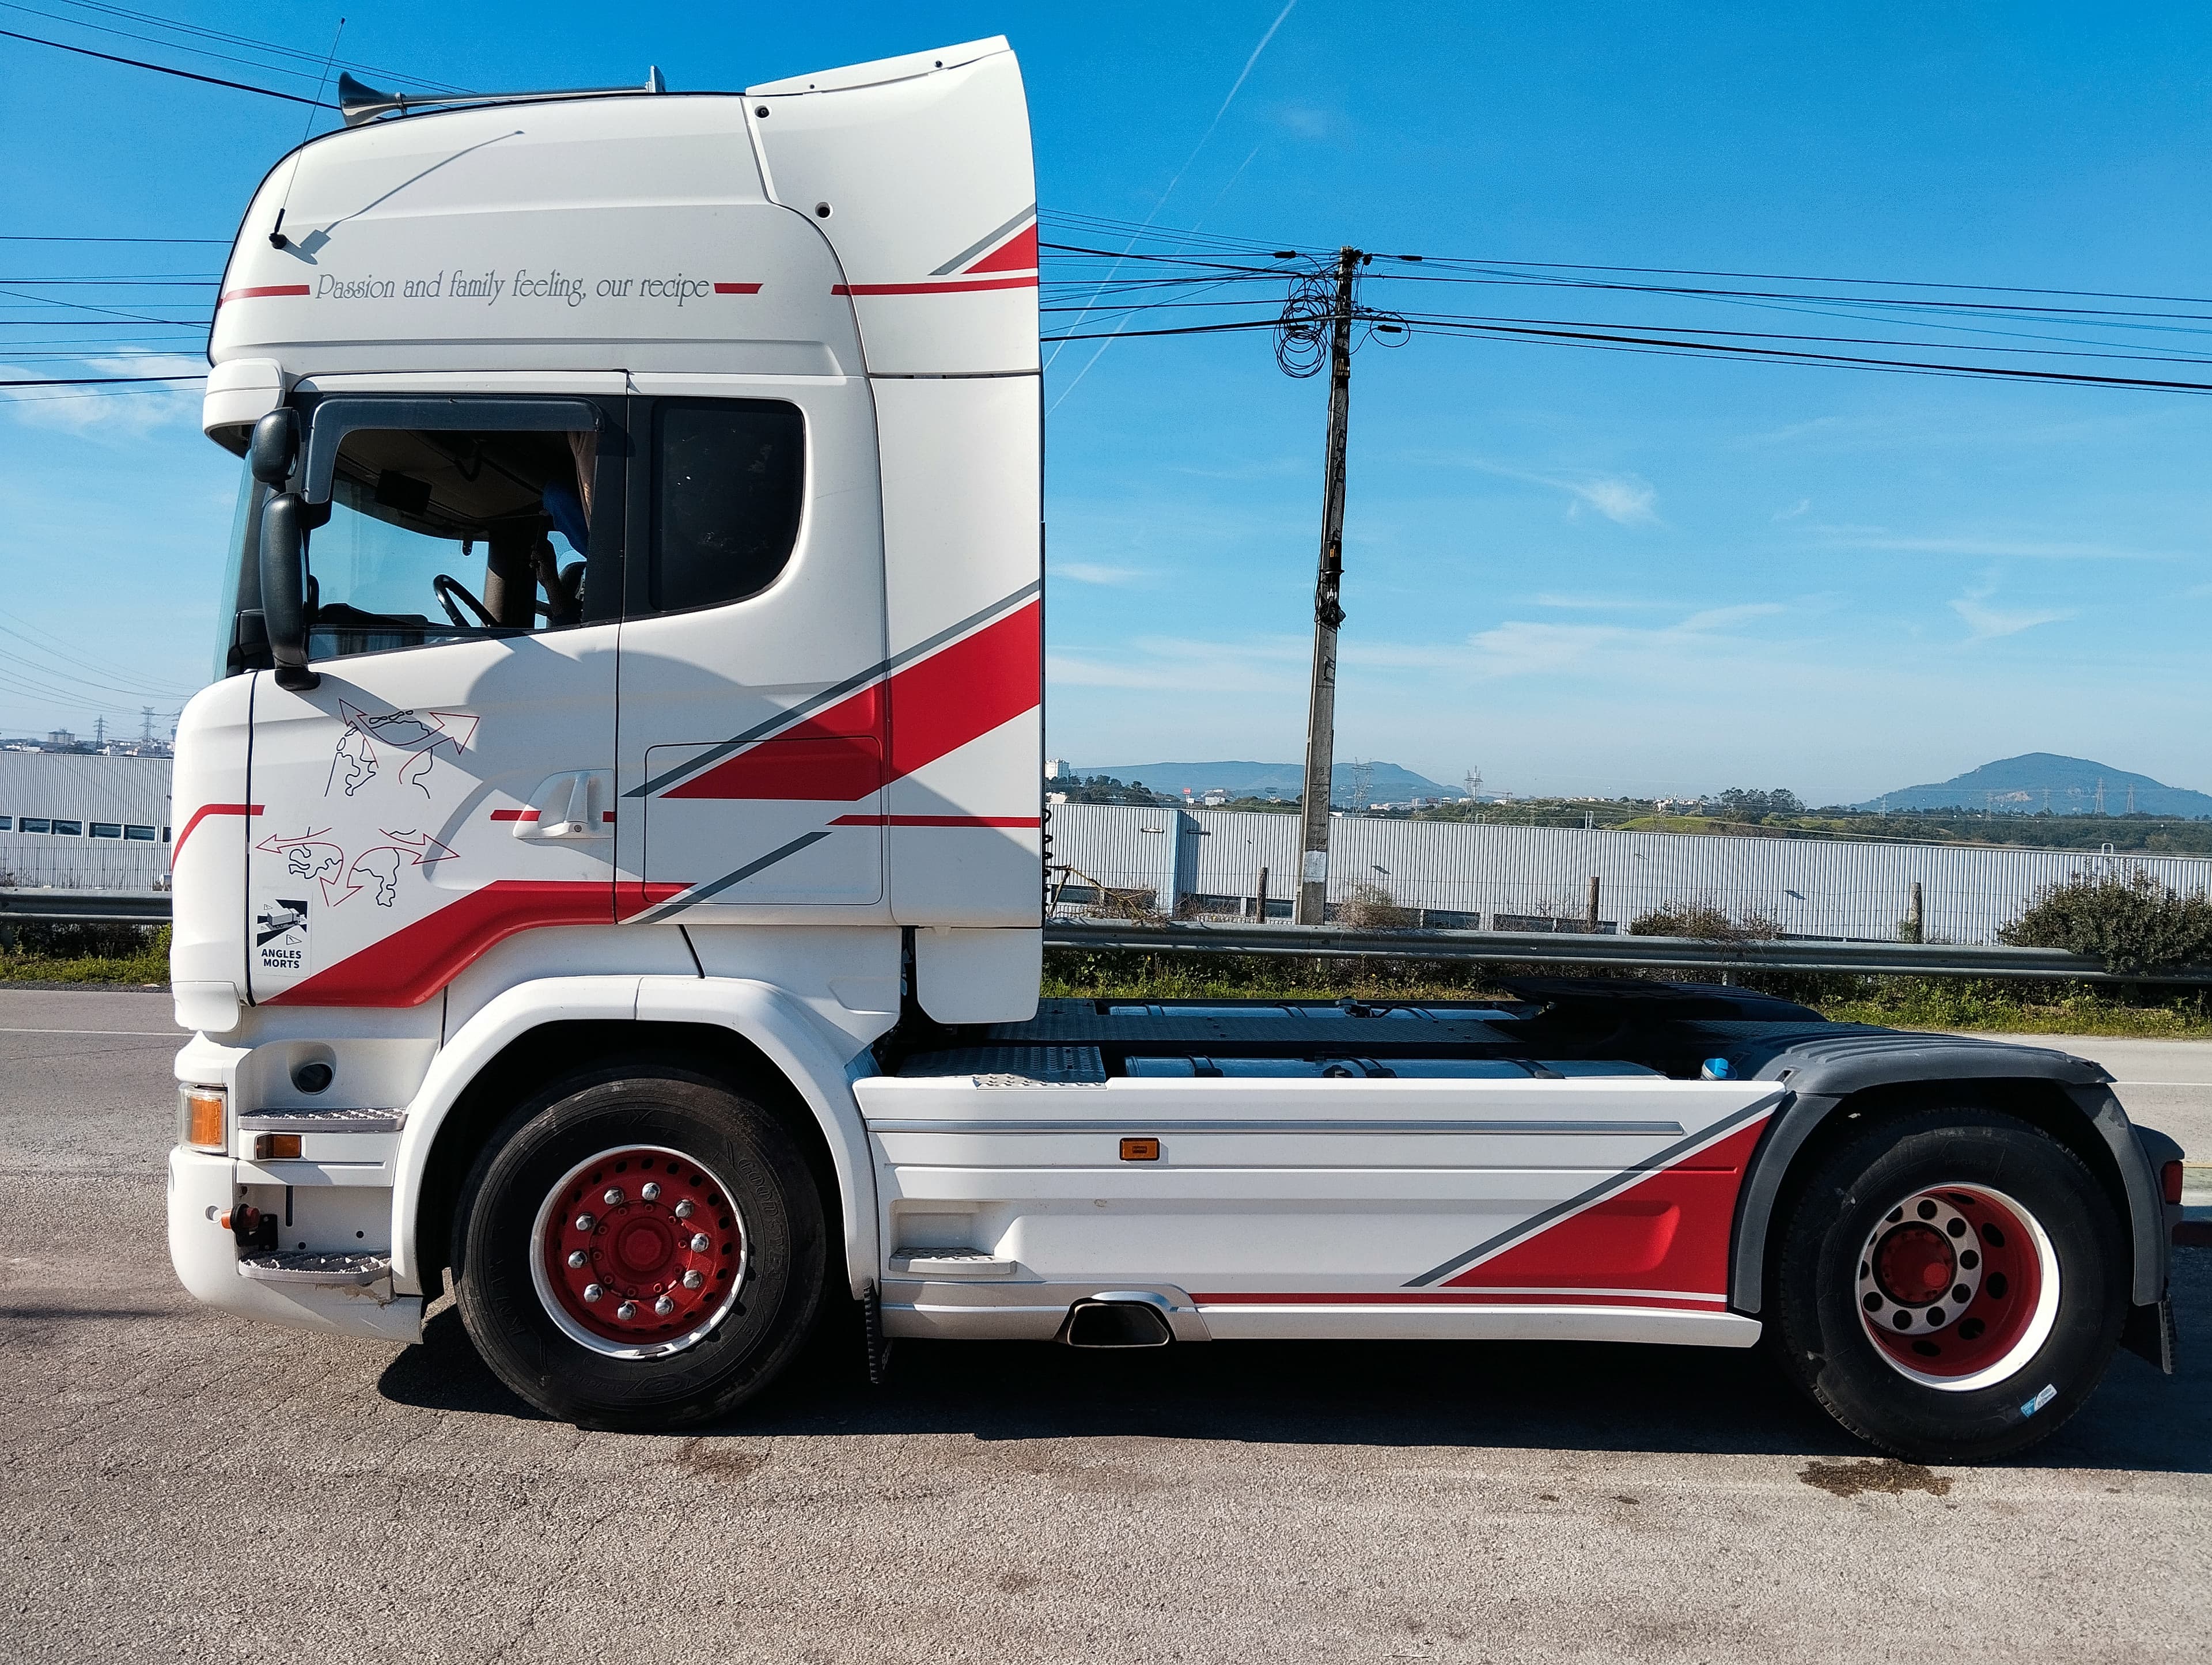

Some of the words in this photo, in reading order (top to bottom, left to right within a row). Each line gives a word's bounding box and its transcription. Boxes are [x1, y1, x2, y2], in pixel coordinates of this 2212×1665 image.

[315, 273, 395, 299] Passion
[403, 270, 444, 298] and
[448, 270, 506, 306] family
[512, 269, 586, 307] feeling,
[597, 279, 634, 297] our
[639, 273, 710, 307] recipe
[261, 949, 301, 959] ANGLES
[263, 958, 300, 968] MORTS
